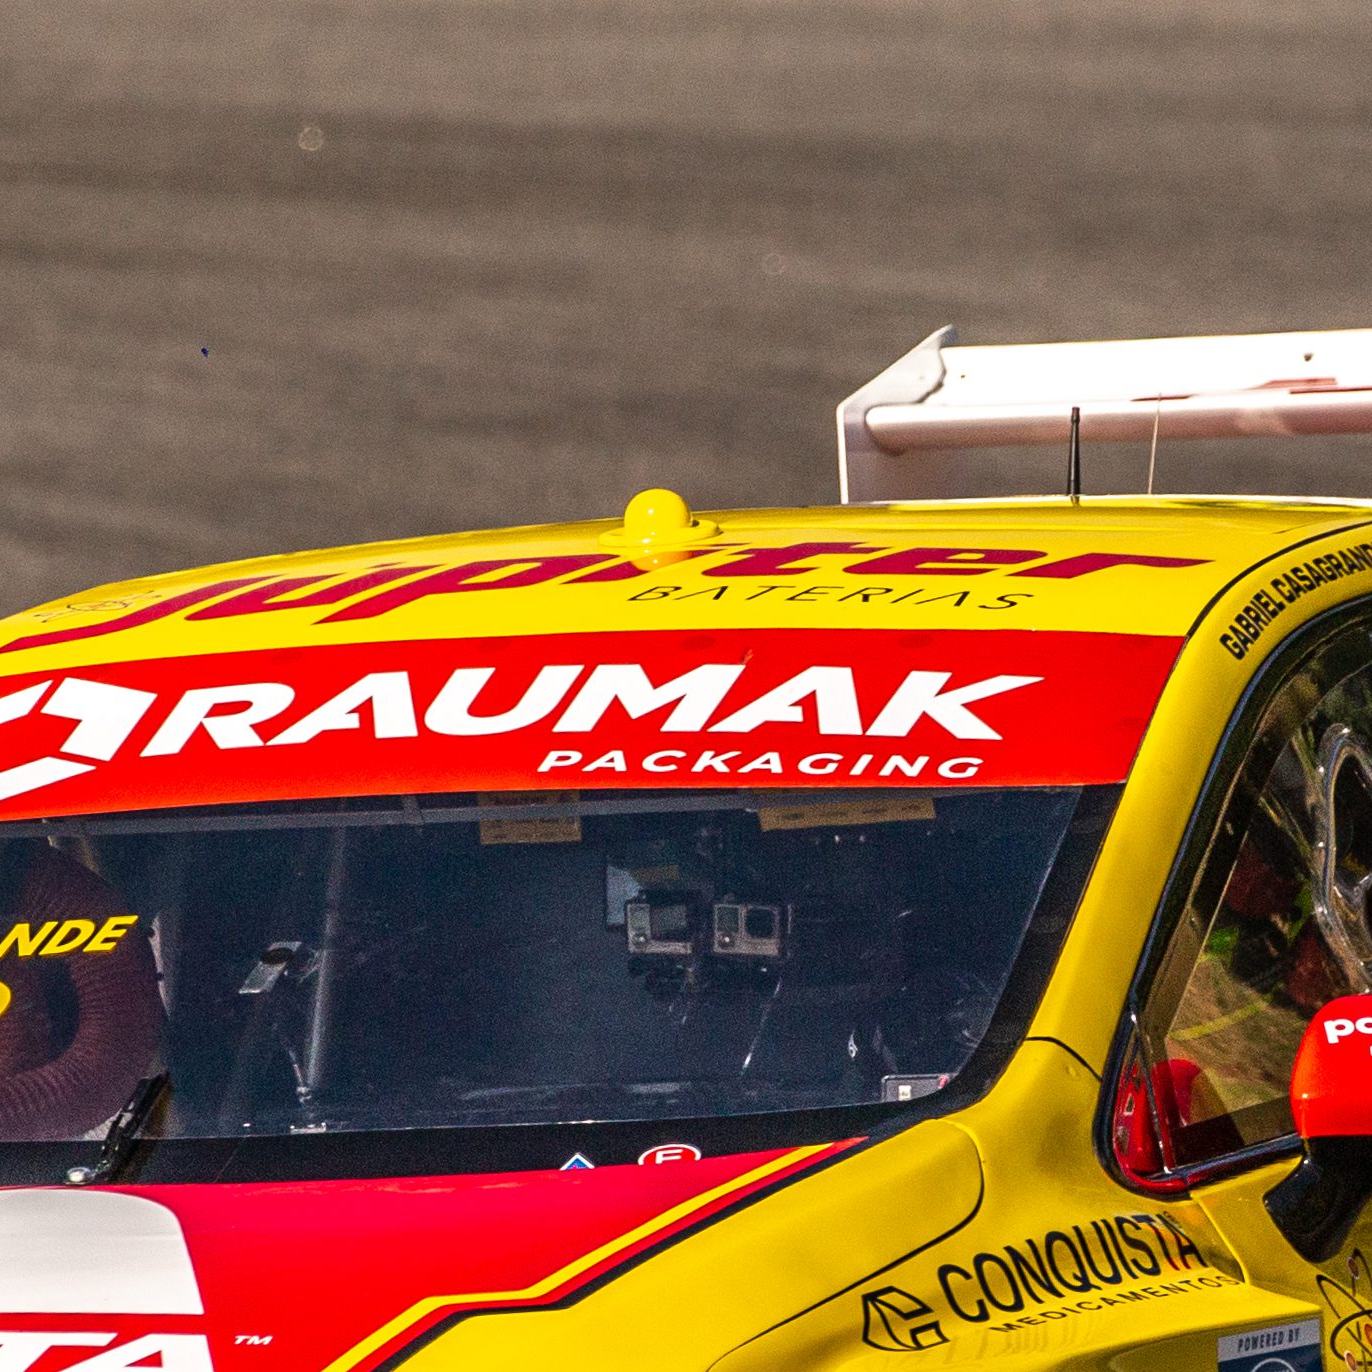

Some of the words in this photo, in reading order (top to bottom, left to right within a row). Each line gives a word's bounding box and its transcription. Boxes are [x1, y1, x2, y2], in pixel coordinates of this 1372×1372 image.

[627, 585, 1035, 611] BATERIAS
[1219, 589, 1286, 661] GABRIEL
[142, 661, 1044, 757] RAUMAK
[537, 750, 984, 781] PACKAGING
[938, 1211, 1209, 1324] CONQUISTA
[988, 1275, 1242, 1334] MEDICAMENTOS
[1237, 1331, 1284, 1352] POWERED
[1287, 1328, 1301, 1342] BY
